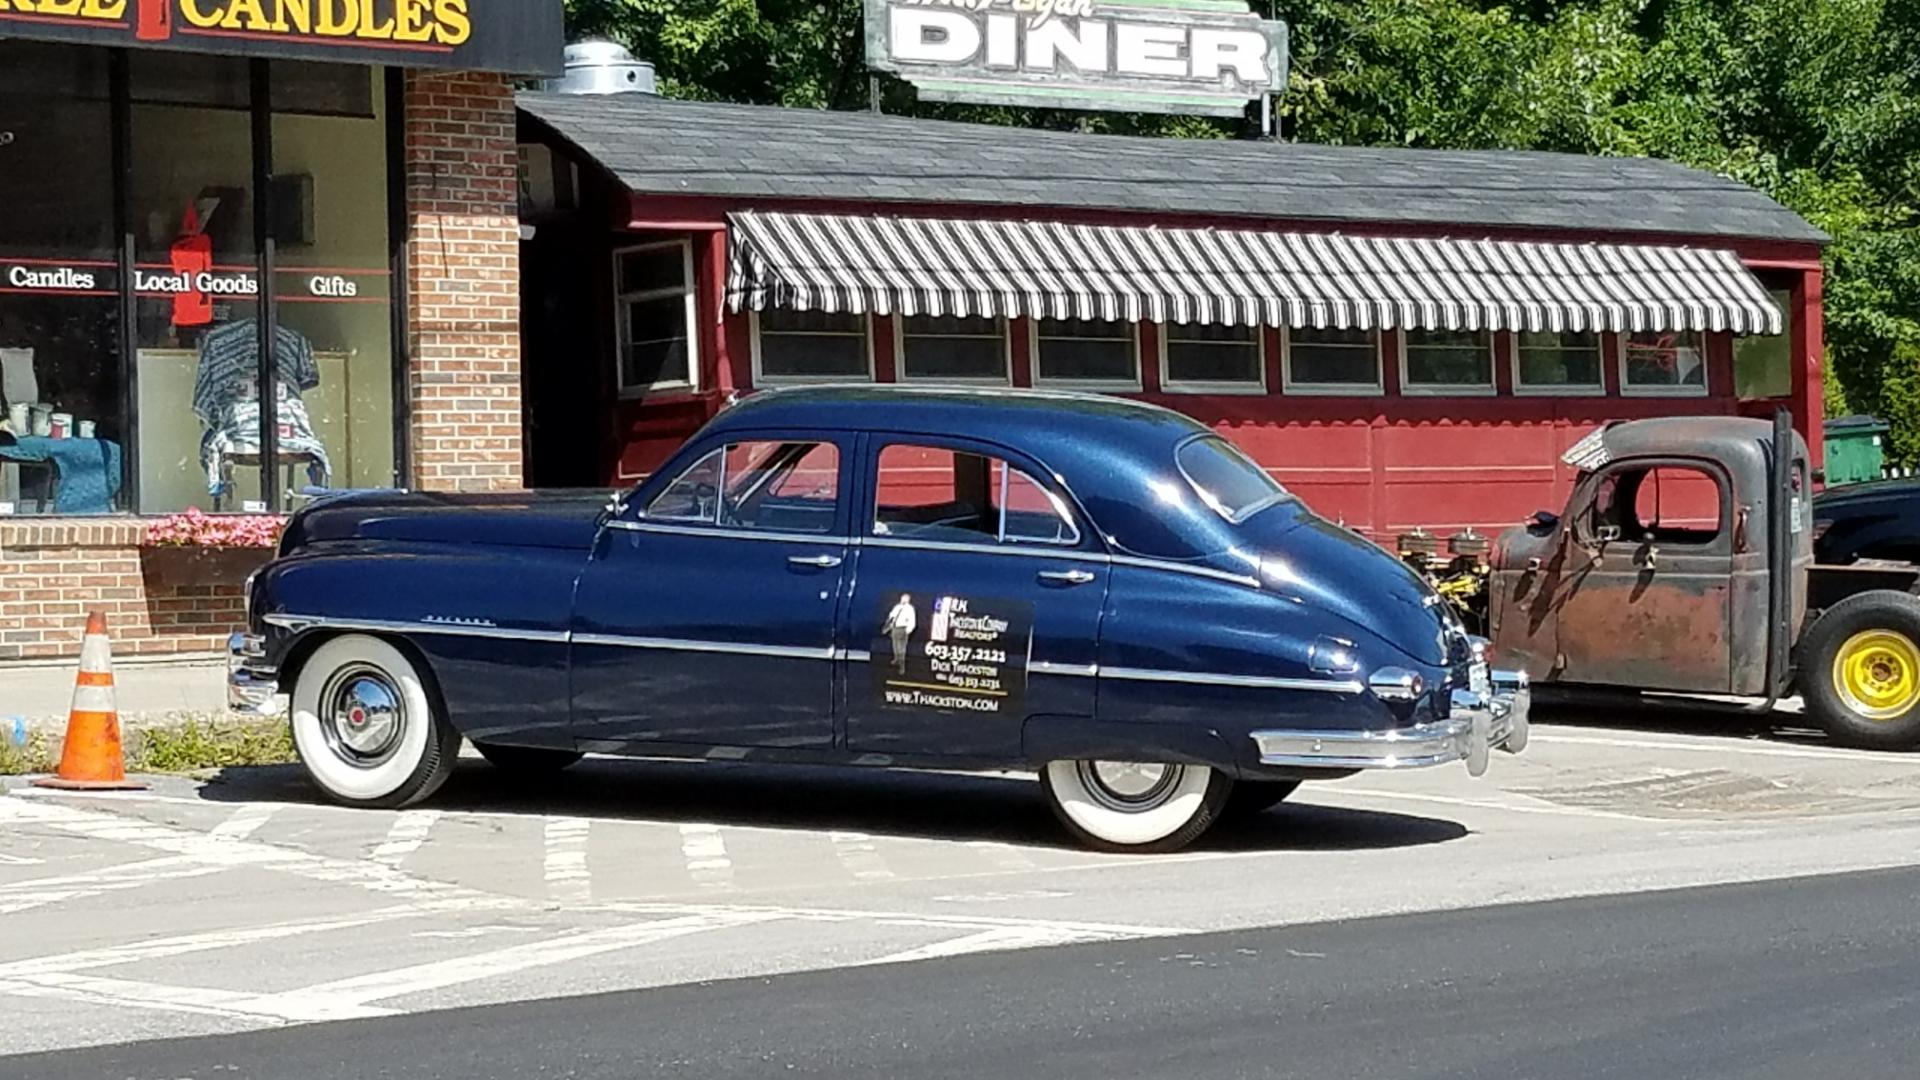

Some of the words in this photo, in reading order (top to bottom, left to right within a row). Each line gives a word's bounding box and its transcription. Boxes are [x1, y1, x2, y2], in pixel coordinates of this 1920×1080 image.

[180, 0, 471, 45] CANDLES
[889, 8, 1271, 83] DINER
[9, 267, 95, 290] Candles
[134, 271, 191, 292] Local
[195, 272, 258, 294] Goods
[310, 276, 357, 297] Gifts
